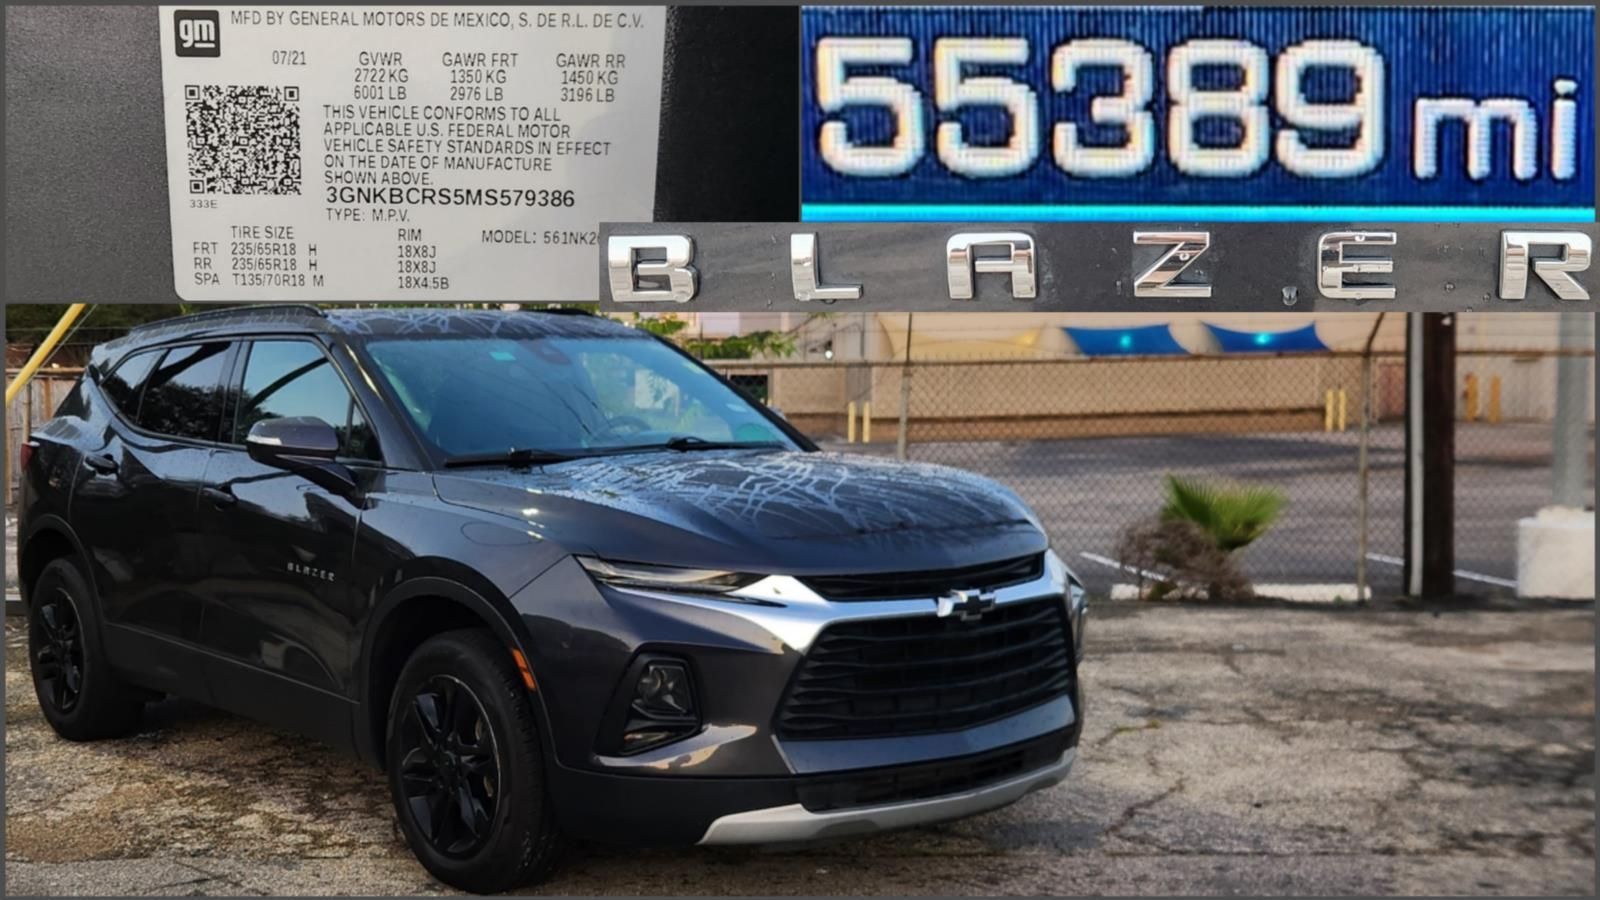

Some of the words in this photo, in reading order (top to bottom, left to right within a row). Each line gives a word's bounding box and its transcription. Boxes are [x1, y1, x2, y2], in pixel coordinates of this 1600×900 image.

[231, 10, 262, 25] MFD
[267, 11, 284, 25] BY
[289, 11, 359, 26] GENERAL
[363, 11, 426, 27] MOTORS
[430, 12, 449, 27] DE
[454, 12, 514, 30] MEXICO,
[518, 12, 532, 28] S.
[537, 13, 557, 28] DE
[561, 13, 588, 28] R.L.
[592, 13, 613, 28] DE
[617, 13, 644, 29] C.V.
[179, 19, 216, 48] gm
[272, 50, 307, 66] 07/21
[359, 51, 403, 66] GVWR
[442, 52, 486, 67] GAWR
[491, 53, 519, 67] FRT
[556, 53, 600, 68] GAWR
[605, 54, 626, 68] RR
[354, 68, 385, 83] 2722
[388, 68, 409, 83] KG
[450, 69, 482, 84] 1350
[486, 69, 506, 84] KG
[561, 70, 594, 85] 1450
[597, 70, 619, 85] KG
[354, 85, 384, 100] 6001
[389, 86, 407, 100] LB
[450, 86, 481, 101] 2976
[486, 87, 504, 101] LB
[561, 87, 593, 102] 3196
[597, 88, 616, 102] LB
[323, 104, 355, 119] THIS
[359, 105, 420, 120] VEHICLE
[423, 105, 506, 121] CONFORMS
[510, 106, 530, 121] TO
[533, 107, 561, 121] ALL
[816, 37, 1384, 179] 55389
[1413, 79, 1577, 181] mi
[323, 121, 412, 136] APPLICABLE
[416, 122, 444, 137] U.S.
[448, 123, 514, 137] FEDERAL
[518, 124, 571, 138] MOTOR
[324, 138, 384, 153] VEHICLE
[387, 138, 442, 153] SAFETY
[447, 139, 534, 154] STANDARDS
[537, 140, 552, 155] IN
[556, 141, 611, 156] EFFECT
[324, 154, 344, 169] ON
[350, 155, 377, 169] THE
[380, 155, 416, 170] DATE
[420, 155, 440, 169] OF
[444, 156, 553, 171] MANUFACTURE
[324, 170, 377, 185] SHOWN
[381, 171, 434, 186] ABOVE.
[326, 186, 576, 207] 3GNKBCRS5MS579386
[190, 200, 218, 209] 333E
[326, 208, 366, 222] TYPE:
[372, 208, 410, 222] M.P.V.
[231, 226, 261, 239] TIRE
[264, 226, 295, 240] SIZE
[397, 228, 422, 242] RIM
[481, 229, 537, 244] MODEL:
[543, 231, 600, 245] 561NK2
[193, 242, 219, 255] FRT
[231, 242, 297, 256] 235/65R18
[308, 244, 318, 256] H
[397, 245, 437, 259] 18X8J
[194, 257, 213, 270] RR
[231, 257, 298, 271] 235/65R18
[308, 259, 318, 271] H
[397, 260, 437, 274] 18X8J
[607, 231, 1592, 304] BLAZER
[194, 272, 221, 286] SPA
[231, 273, 306, 287] T135/70R18
[313, 275, 324, 287] M
[397, 276, 450, 290] 18X4.5B
[287, 562, 335, 581] BLAZER
